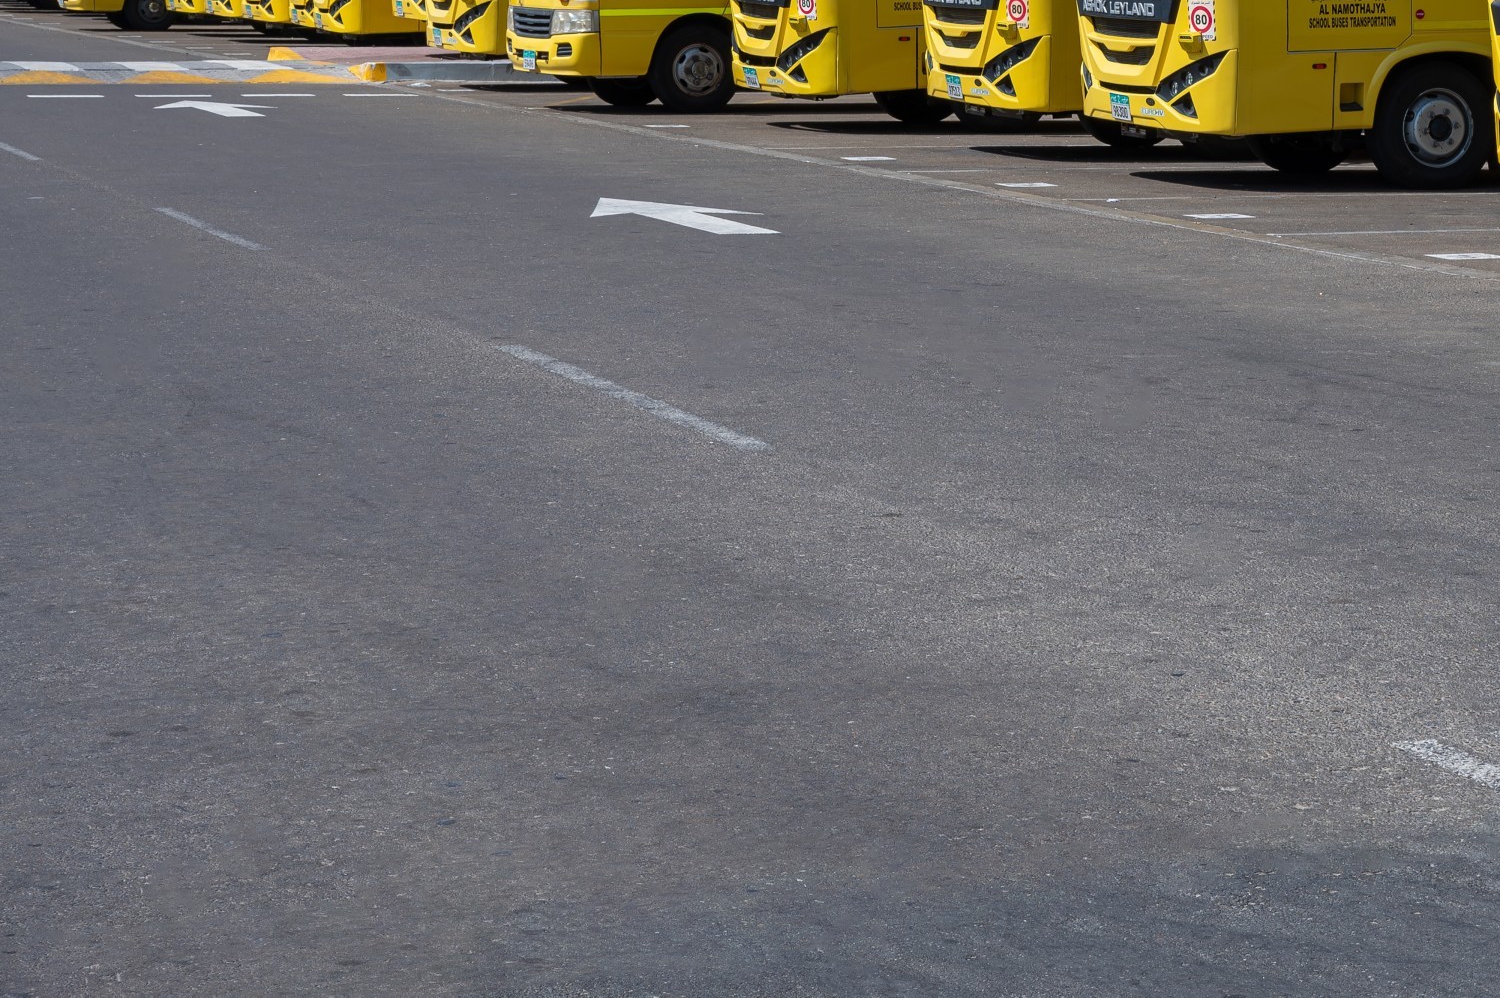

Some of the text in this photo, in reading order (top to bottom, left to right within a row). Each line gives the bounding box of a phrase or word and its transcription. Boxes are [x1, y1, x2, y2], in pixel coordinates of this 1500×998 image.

[802, 0, 811, 8] 80
[1012, 5, 1022, 14] 80
[1109, 1, 1154, 17] LEYLAND
[1319, 3, 1386, 15] AL NAMOTHAJYA
[1195, 14, 1207, 25] 80
[1309, 16, 1397, 29] SCHOOL BUSES TRANSPORTATION
